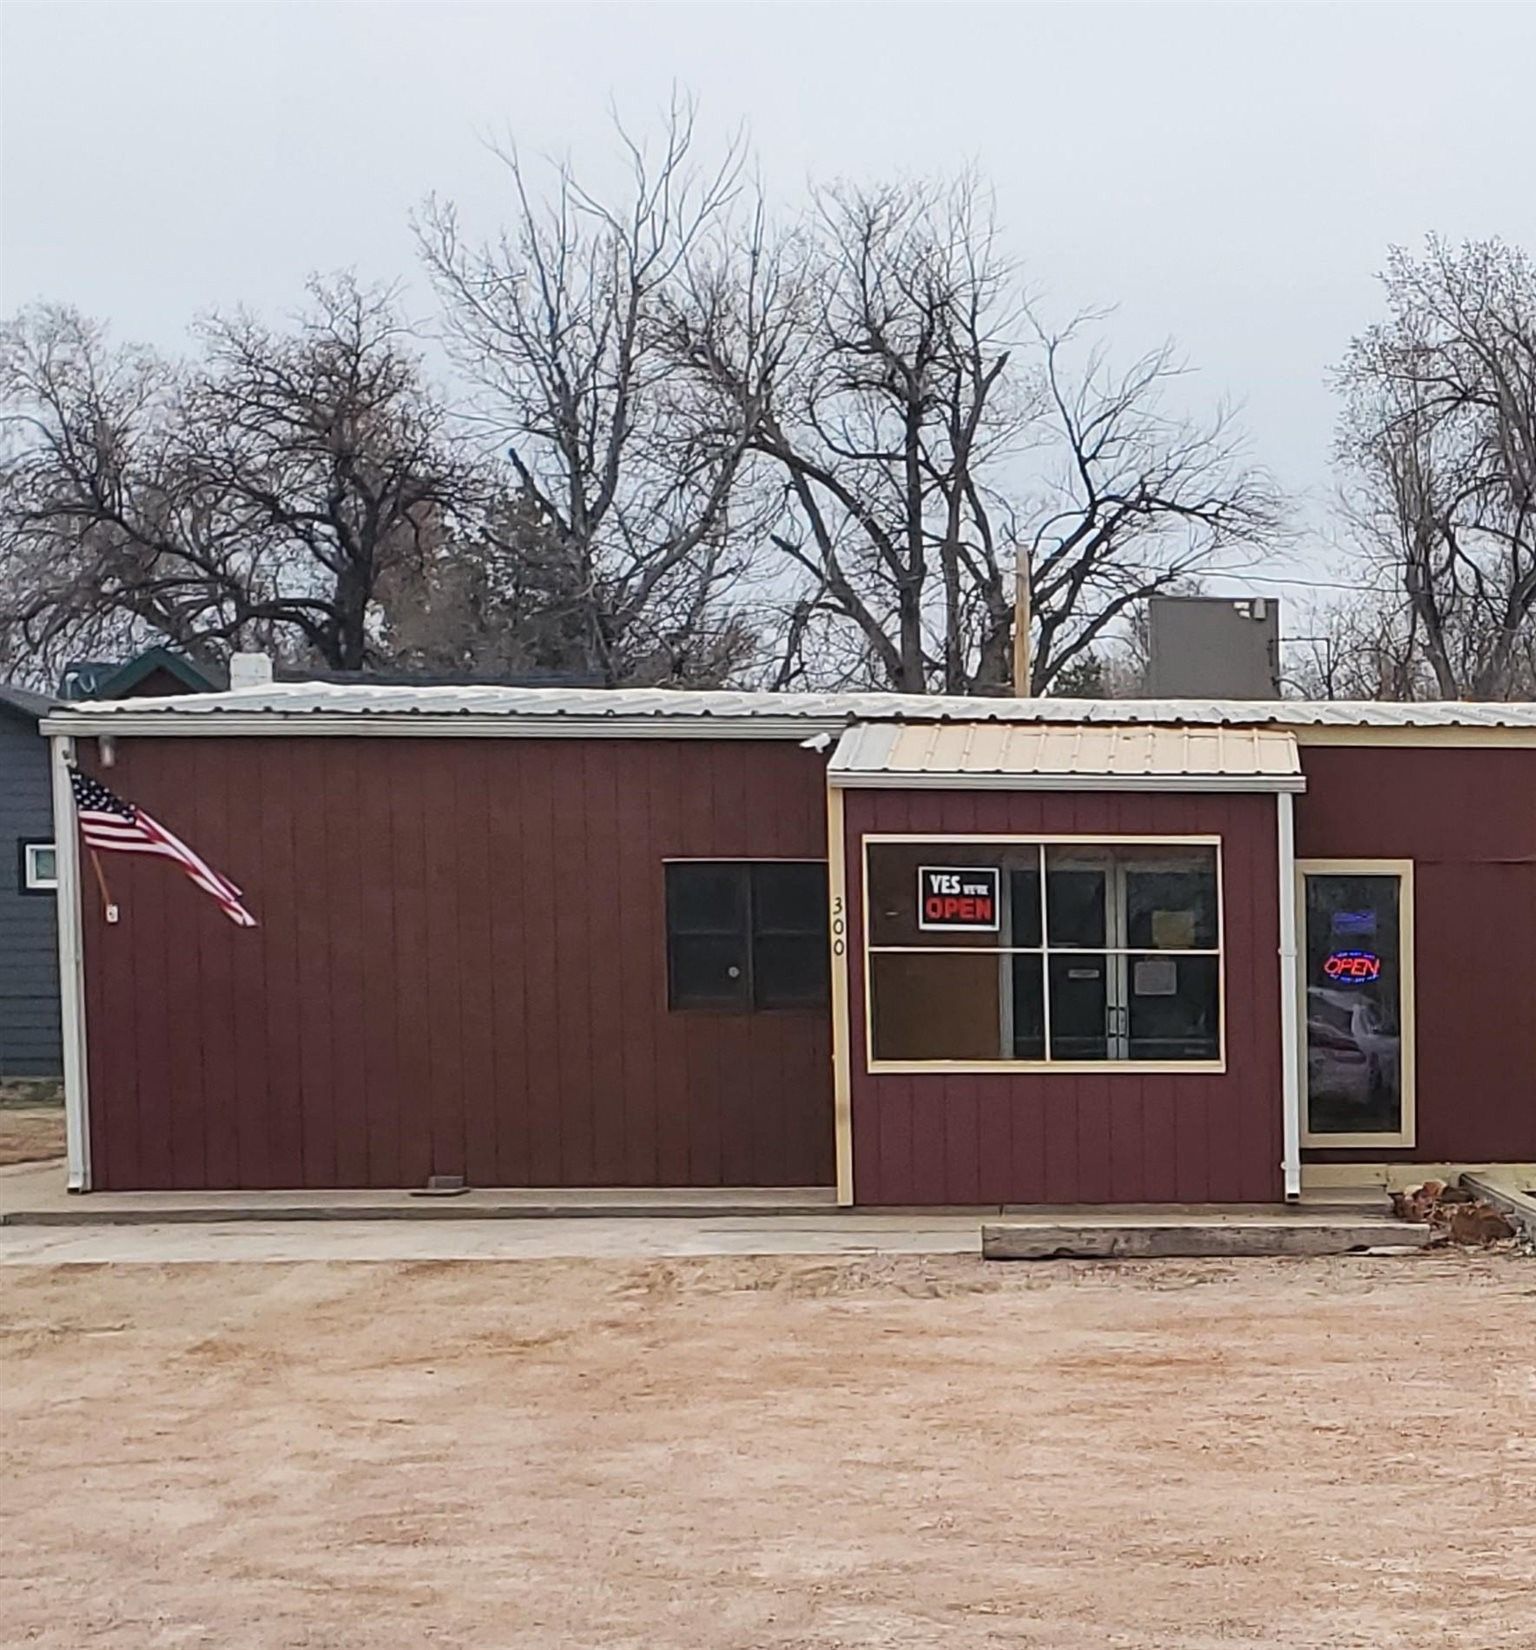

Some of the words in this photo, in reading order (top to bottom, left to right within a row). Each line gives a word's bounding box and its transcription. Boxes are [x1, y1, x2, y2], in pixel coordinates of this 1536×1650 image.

[929, 874, 961, 894] YES
[926, 897, 992, 919] OPEN
[833, 896, 845, 956] 300
[1324, 956, 1380, 977] OPEN
